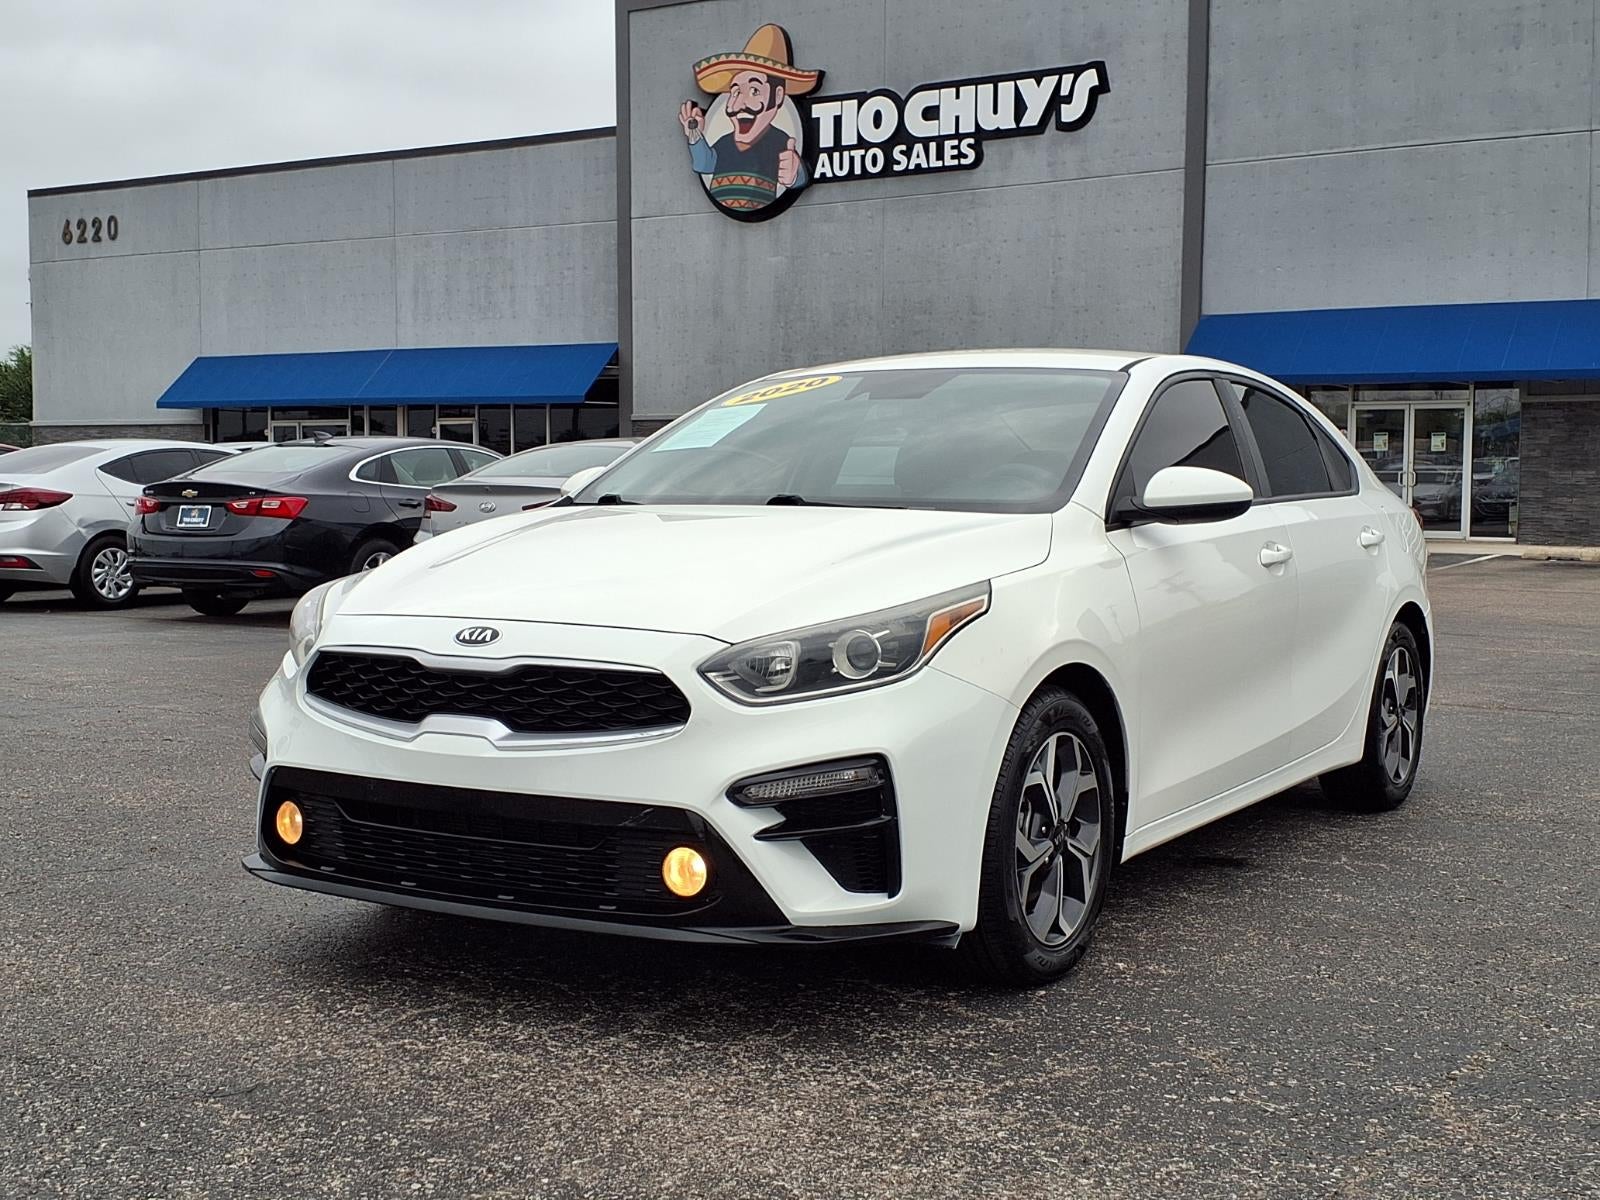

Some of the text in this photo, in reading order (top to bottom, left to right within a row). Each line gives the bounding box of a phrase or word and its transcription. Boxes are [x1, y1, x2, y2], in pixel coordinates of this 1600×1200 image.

[811, 69, 1099, 148] TIO CHUY'S
[814, 138, 976, 179] AUTO SALES
[62, 215, 119, 245] 6220
[734, 378, 829, 403] 2020
[459, 628, 493, 641] KIA
